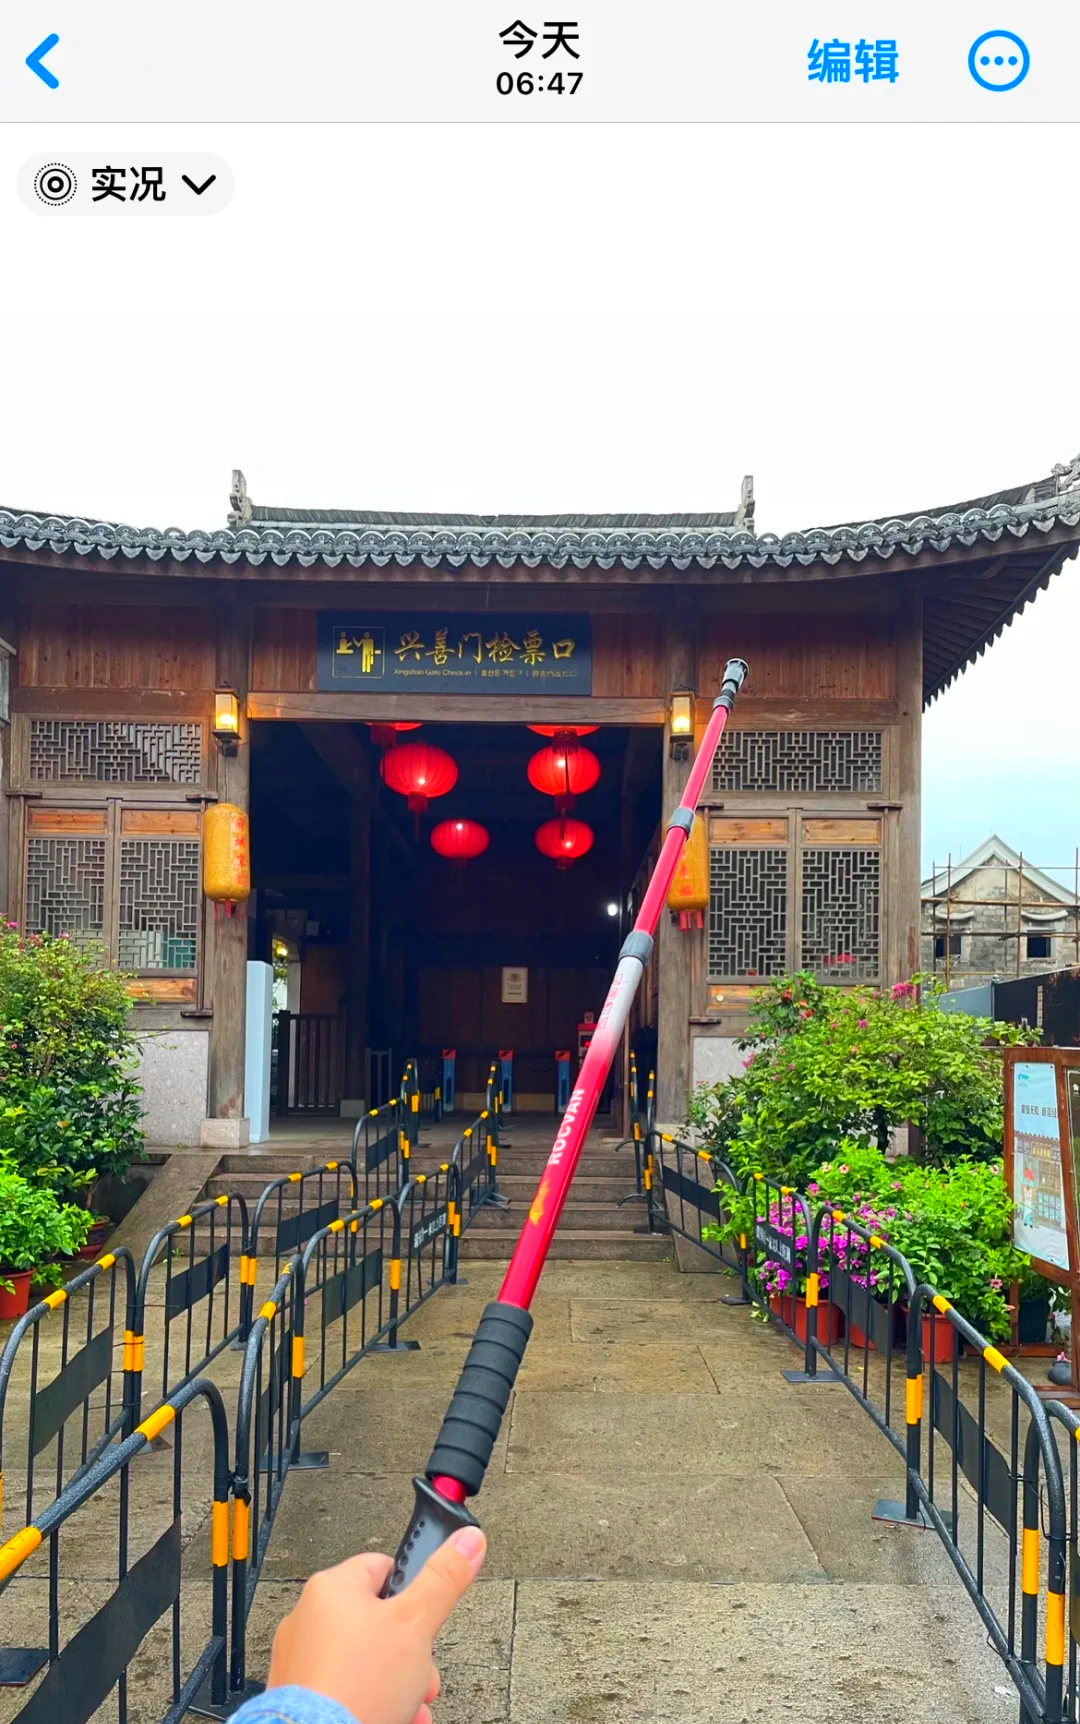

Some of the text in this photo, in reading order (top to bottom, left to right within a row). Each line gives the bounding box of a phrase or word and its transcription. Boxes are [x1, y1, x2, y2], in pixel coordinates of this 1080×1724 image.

[394, 629, 576, 666] 兴善门检票口
[549, 1088, 585, 1165] ROCVAN
